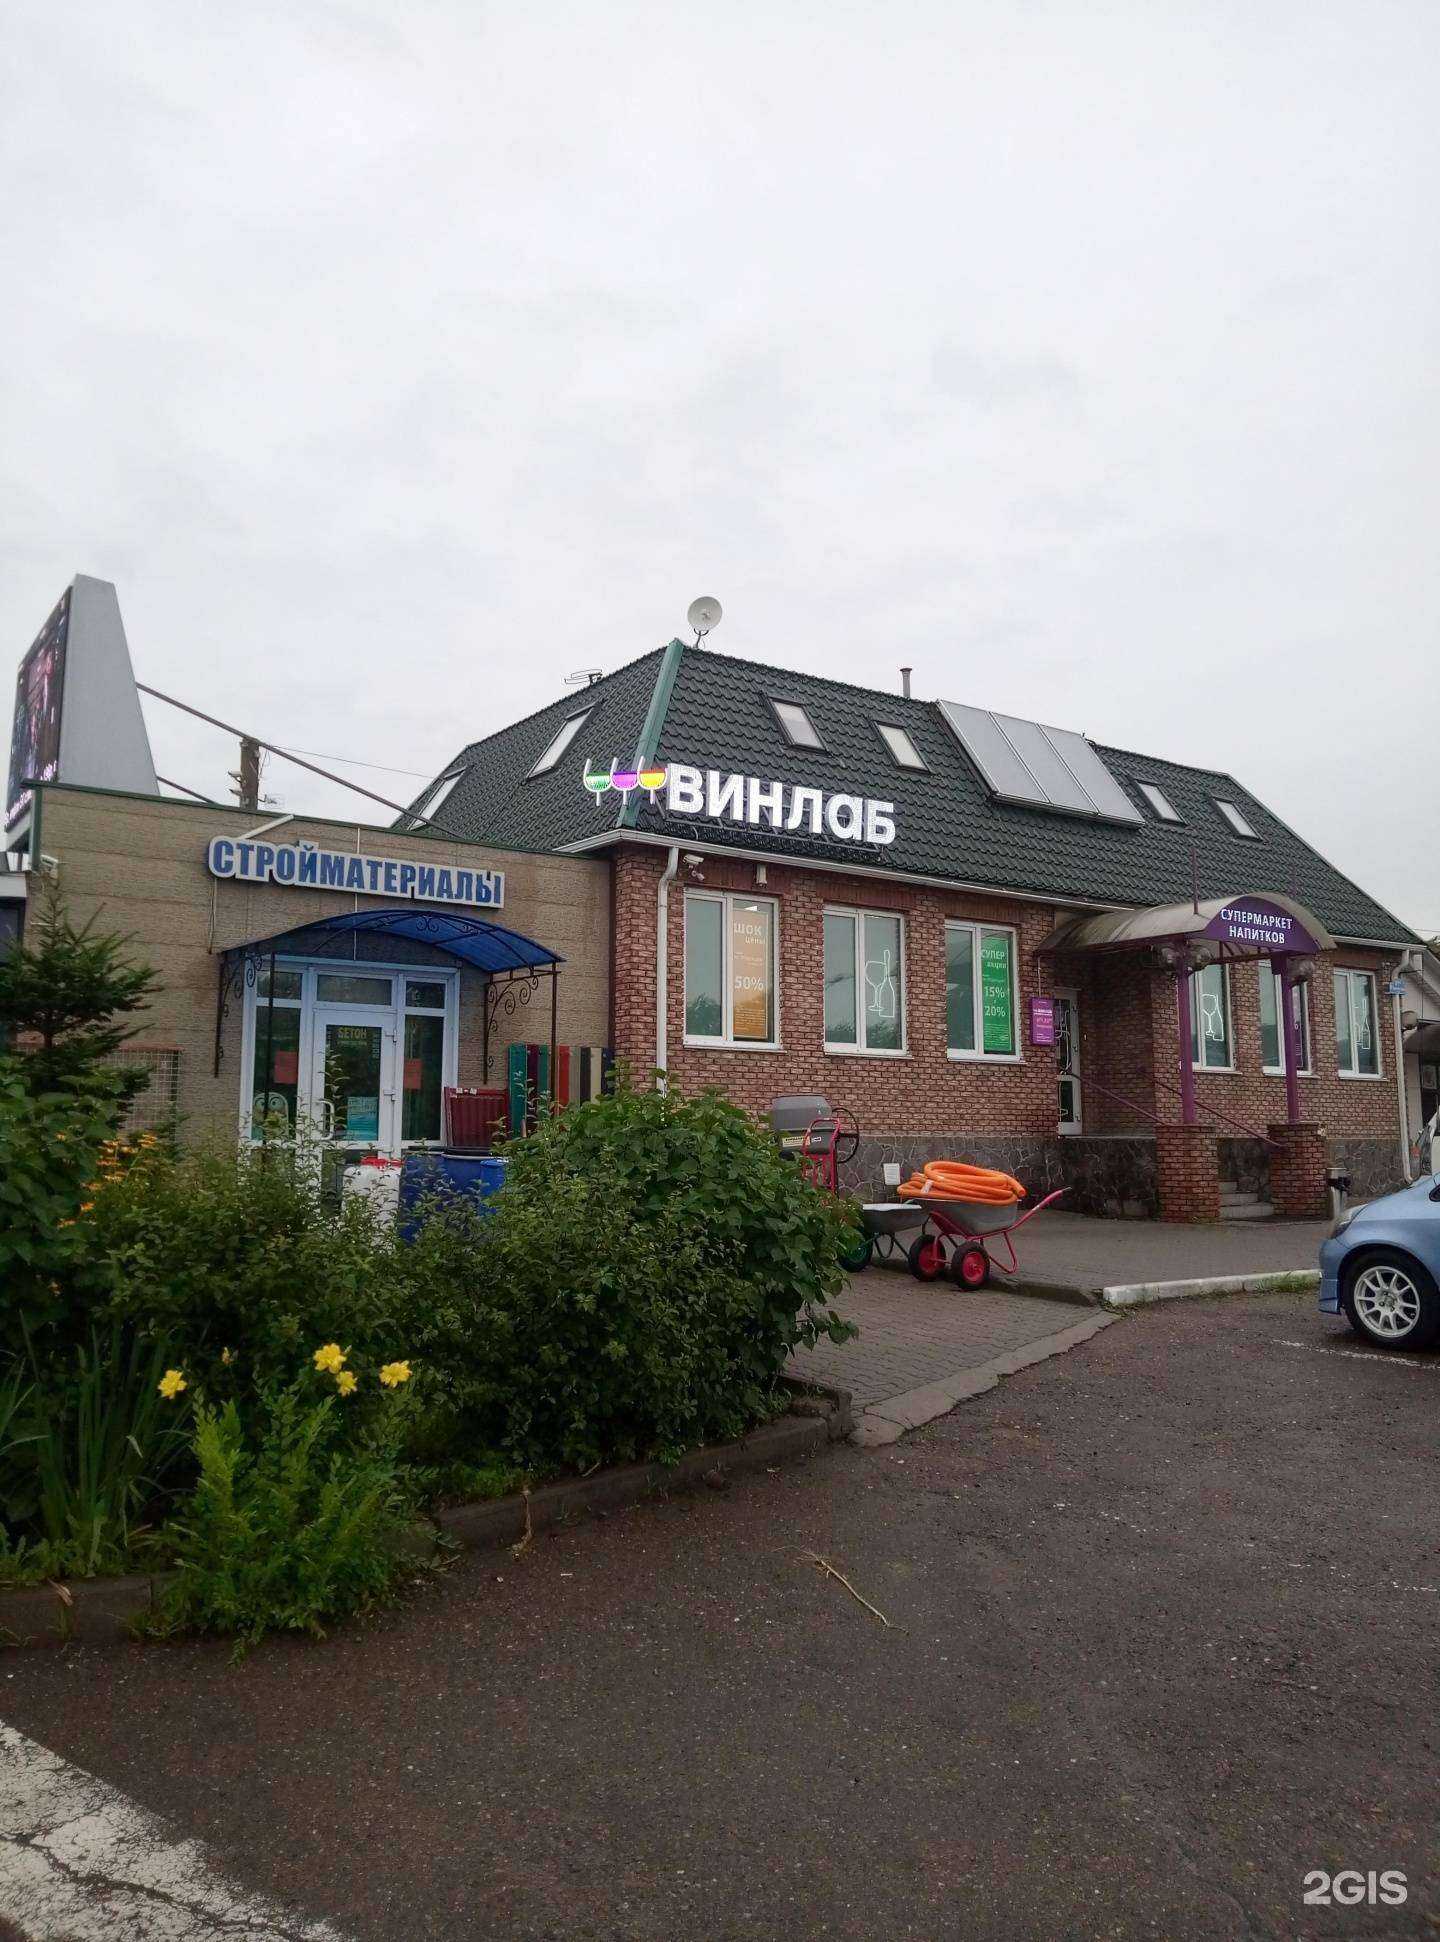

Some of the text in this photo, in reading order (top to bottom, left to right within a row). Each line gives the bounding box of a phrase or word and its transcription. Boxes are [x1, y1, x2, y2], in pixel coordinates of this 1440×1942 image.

[212, 840, 502, 904] СТРОЙМАТЕРИАЛЫ
[1221, 908, 1293, 930] СУПЕРМАРКЕТ
[1229, 925, 1285, 944] НАПИТКОВ
[981, 949, 1006, 960] СУПЕР
[734, 976, 764, 991] 50%
[984, 986, 1006, 998] 15%
[984, 1005, 1006, 1017] 20%
